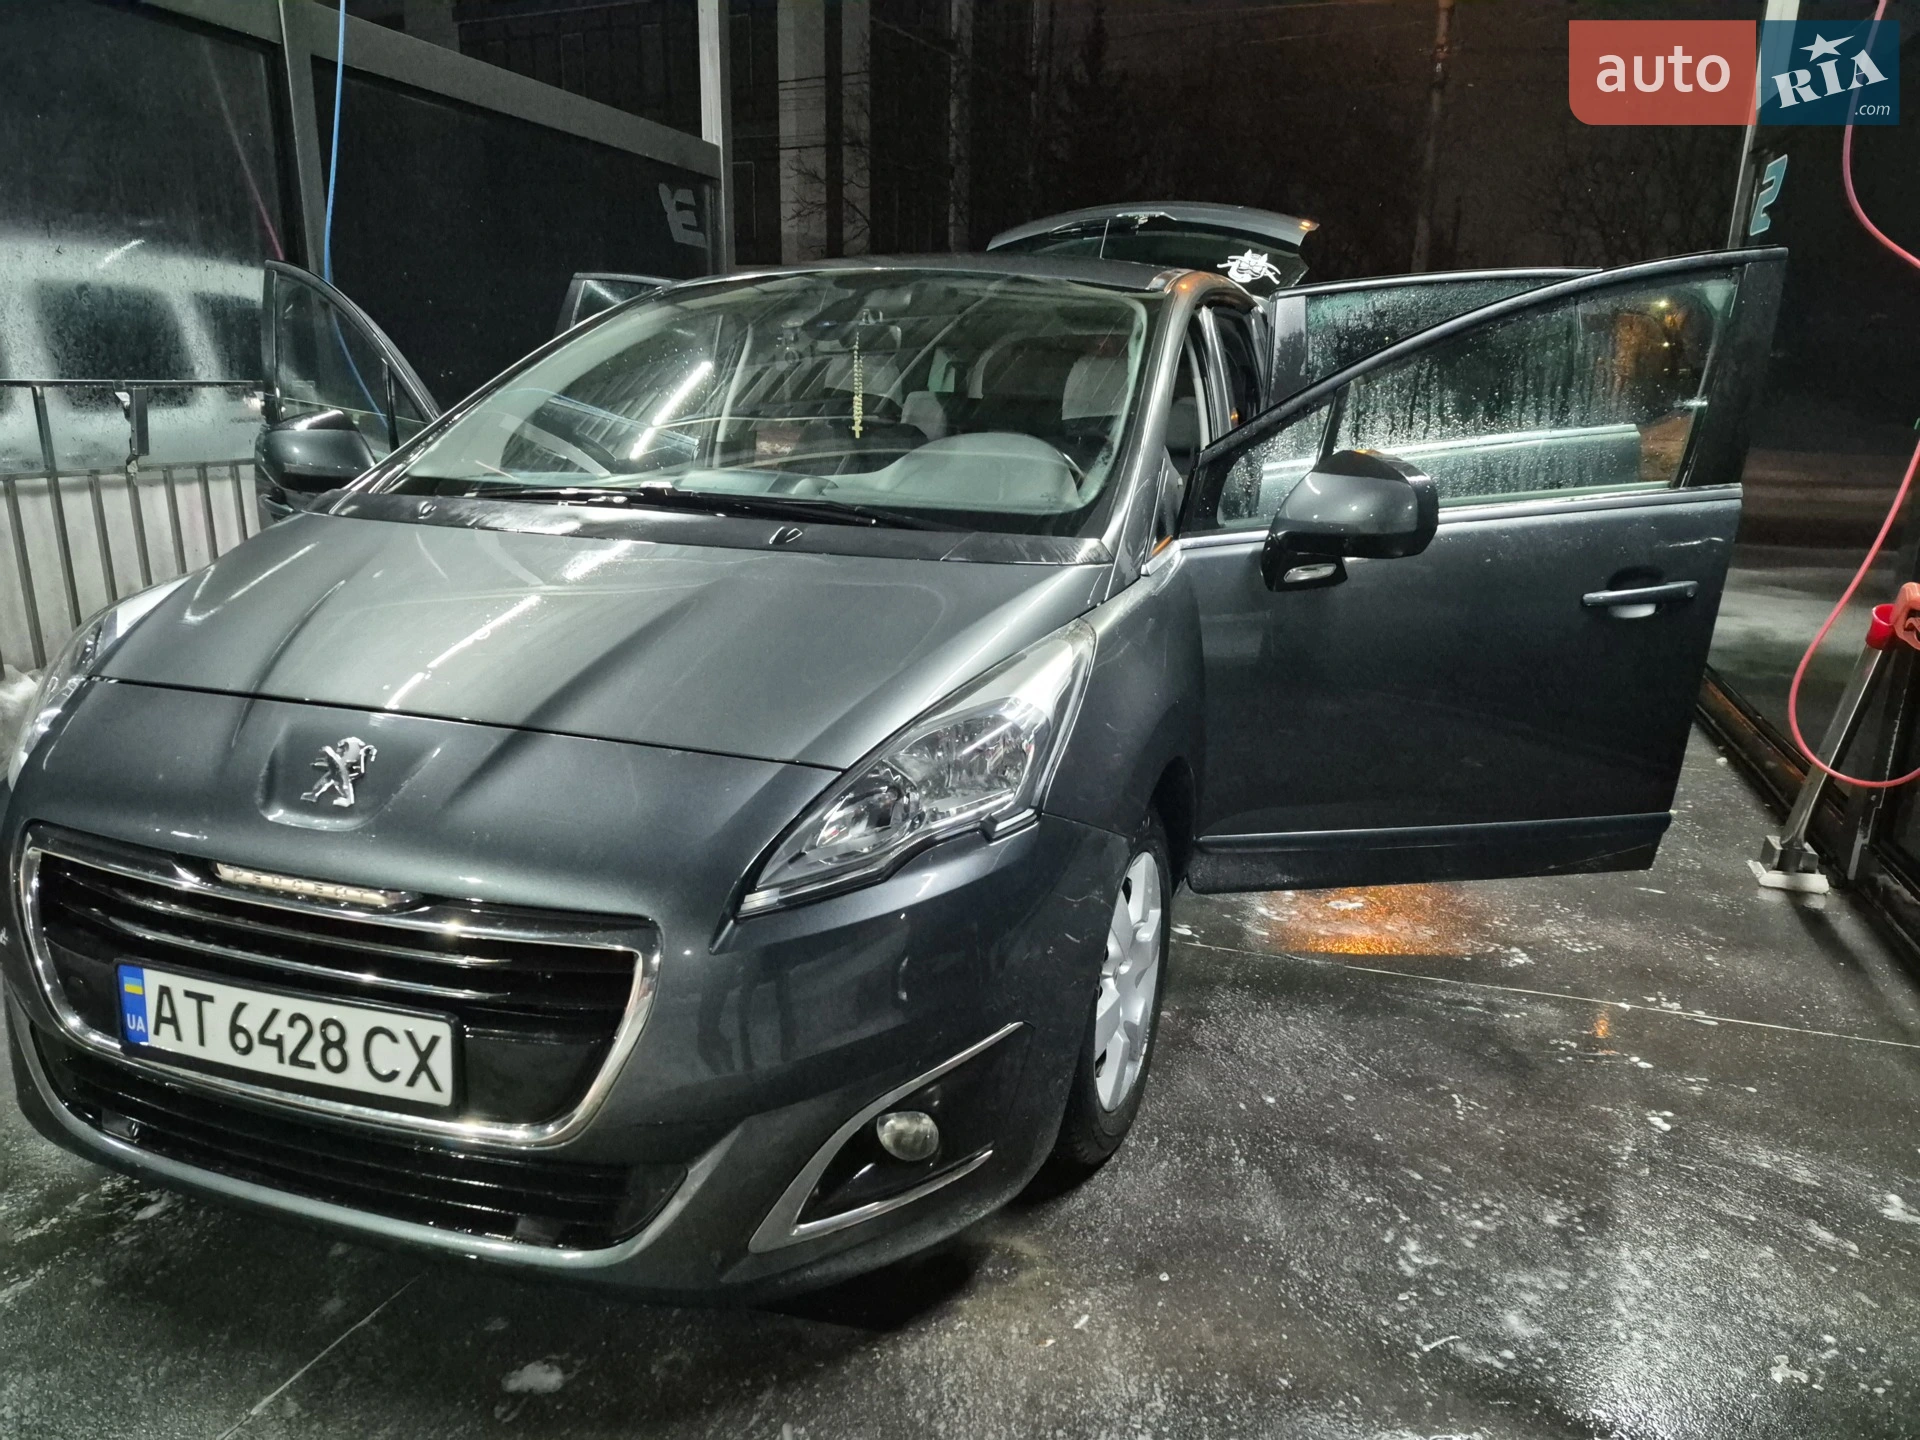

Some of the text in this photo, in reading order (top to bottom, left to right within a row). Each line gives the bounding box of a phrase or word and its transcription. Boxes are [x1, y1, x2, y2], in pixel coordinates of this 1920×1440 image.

[126, 1012, 146, 1033] UA
[152, 984, 444, 1094] AT 6428 CX
